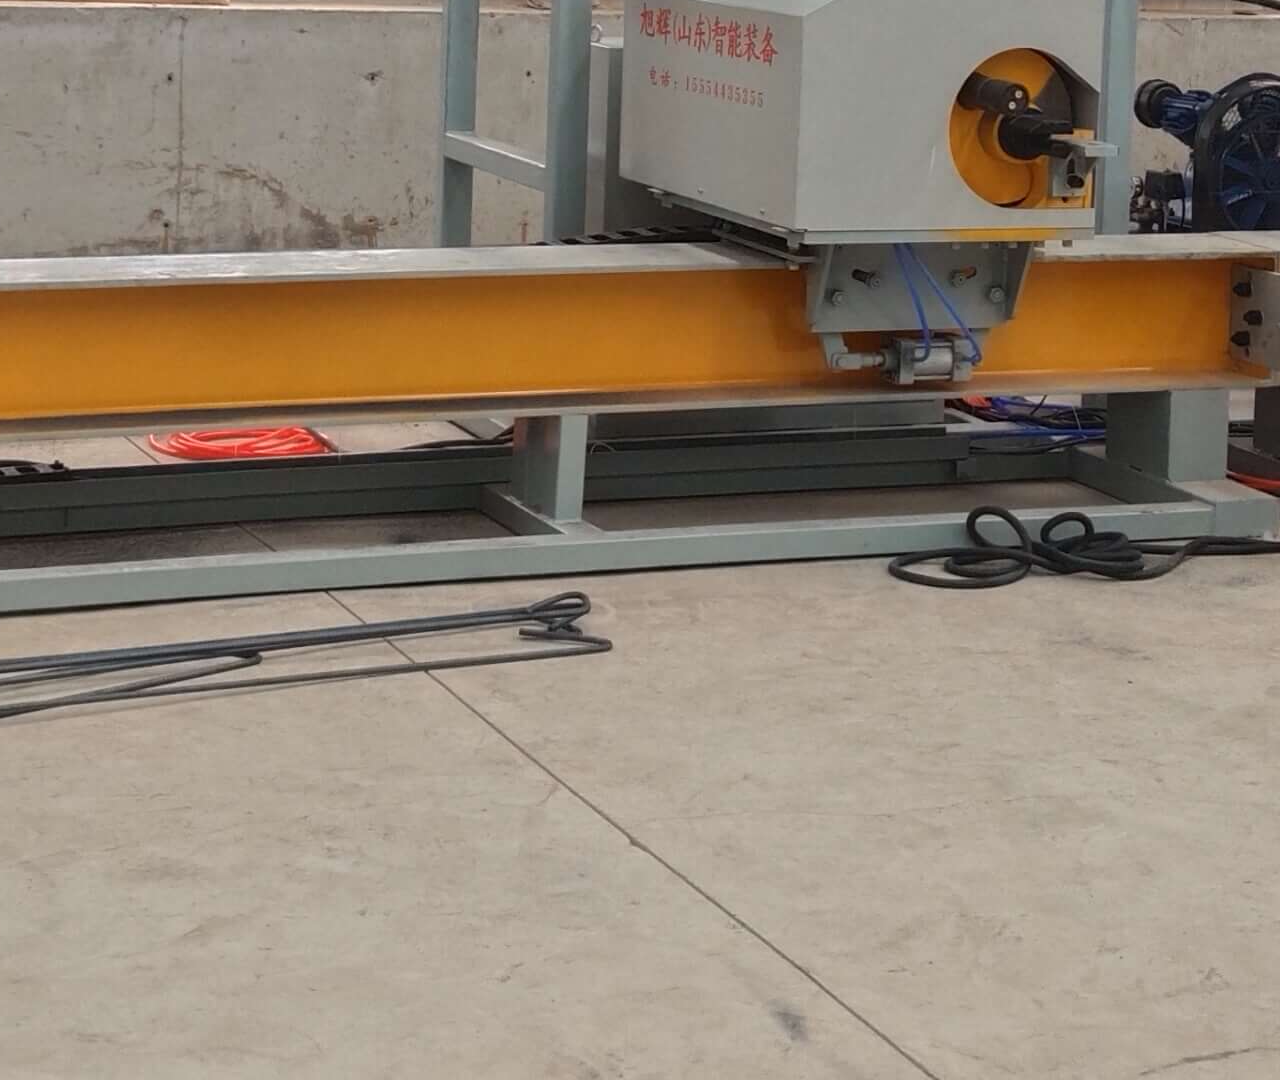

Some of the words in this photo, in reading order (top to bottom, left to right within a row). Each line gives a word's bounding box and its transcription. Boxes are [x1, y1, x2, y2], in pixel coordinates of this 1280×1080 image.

[640, 2, 778, 67] 旭辉(山东)智能装备
